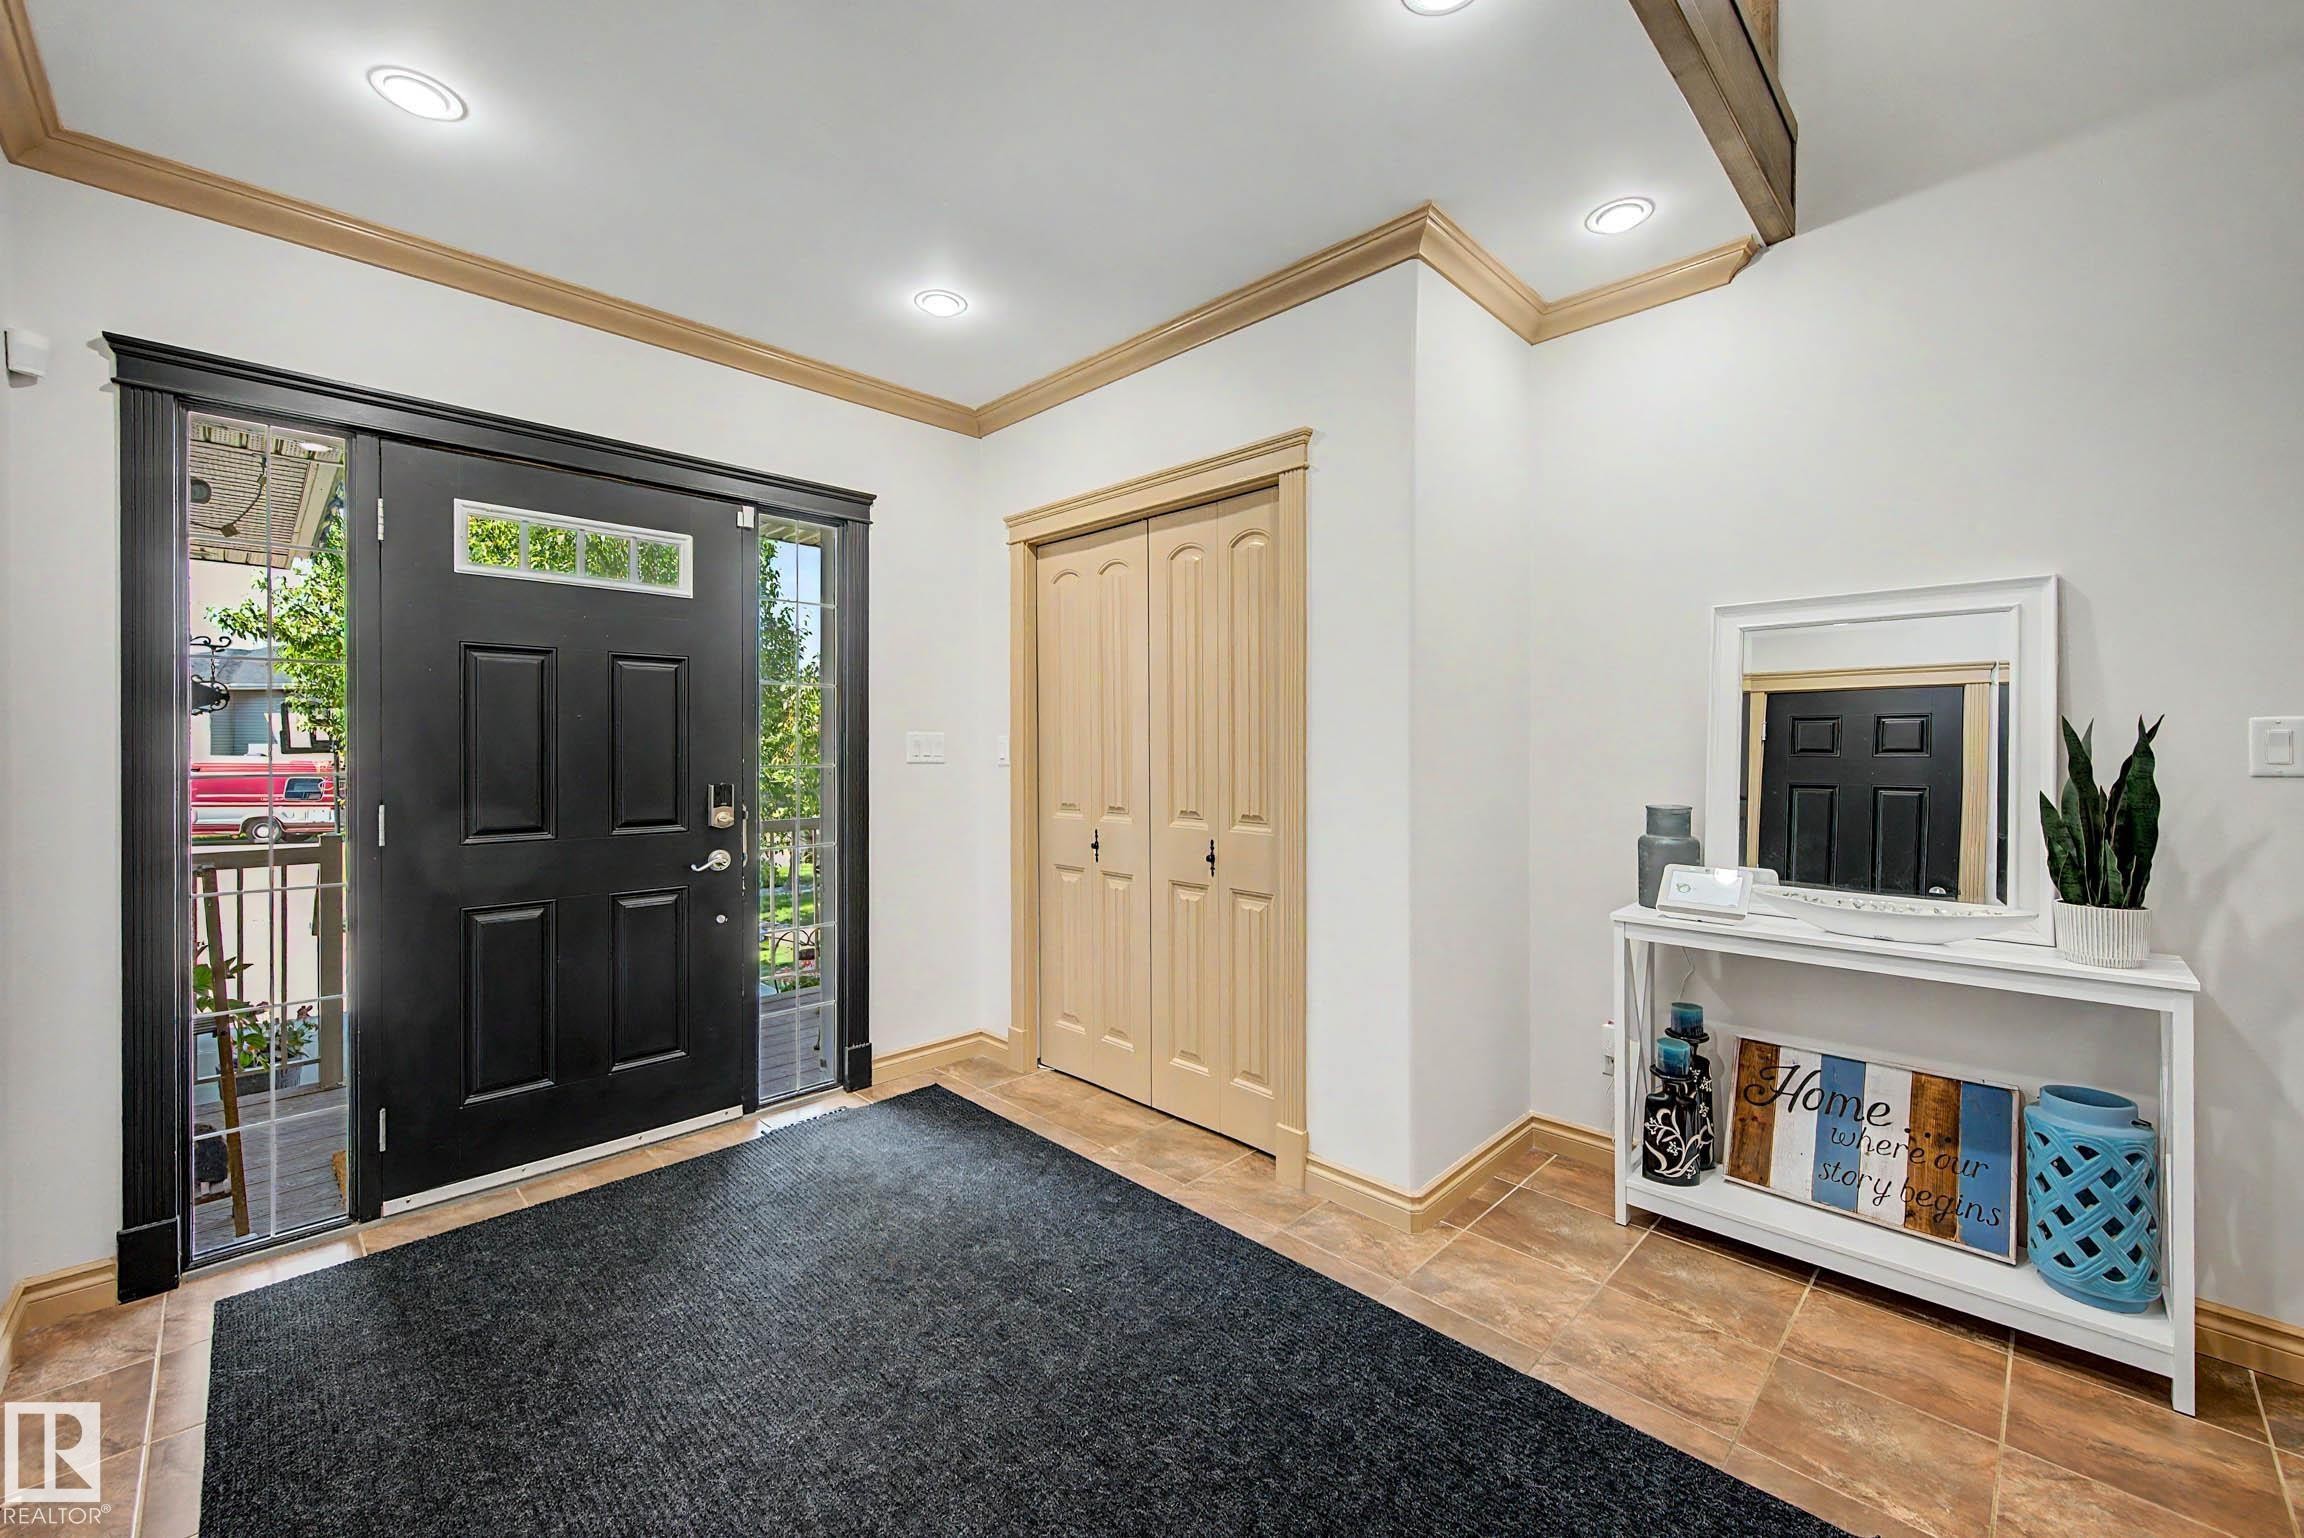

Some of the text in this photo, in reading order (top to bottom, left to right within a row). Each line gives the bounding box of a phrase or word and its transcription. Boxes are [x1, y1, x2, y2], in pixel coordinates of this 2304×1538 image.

[1831, 1127, 1989, 1178] where our
[1818, 1161, 2001, 1226] story begins
